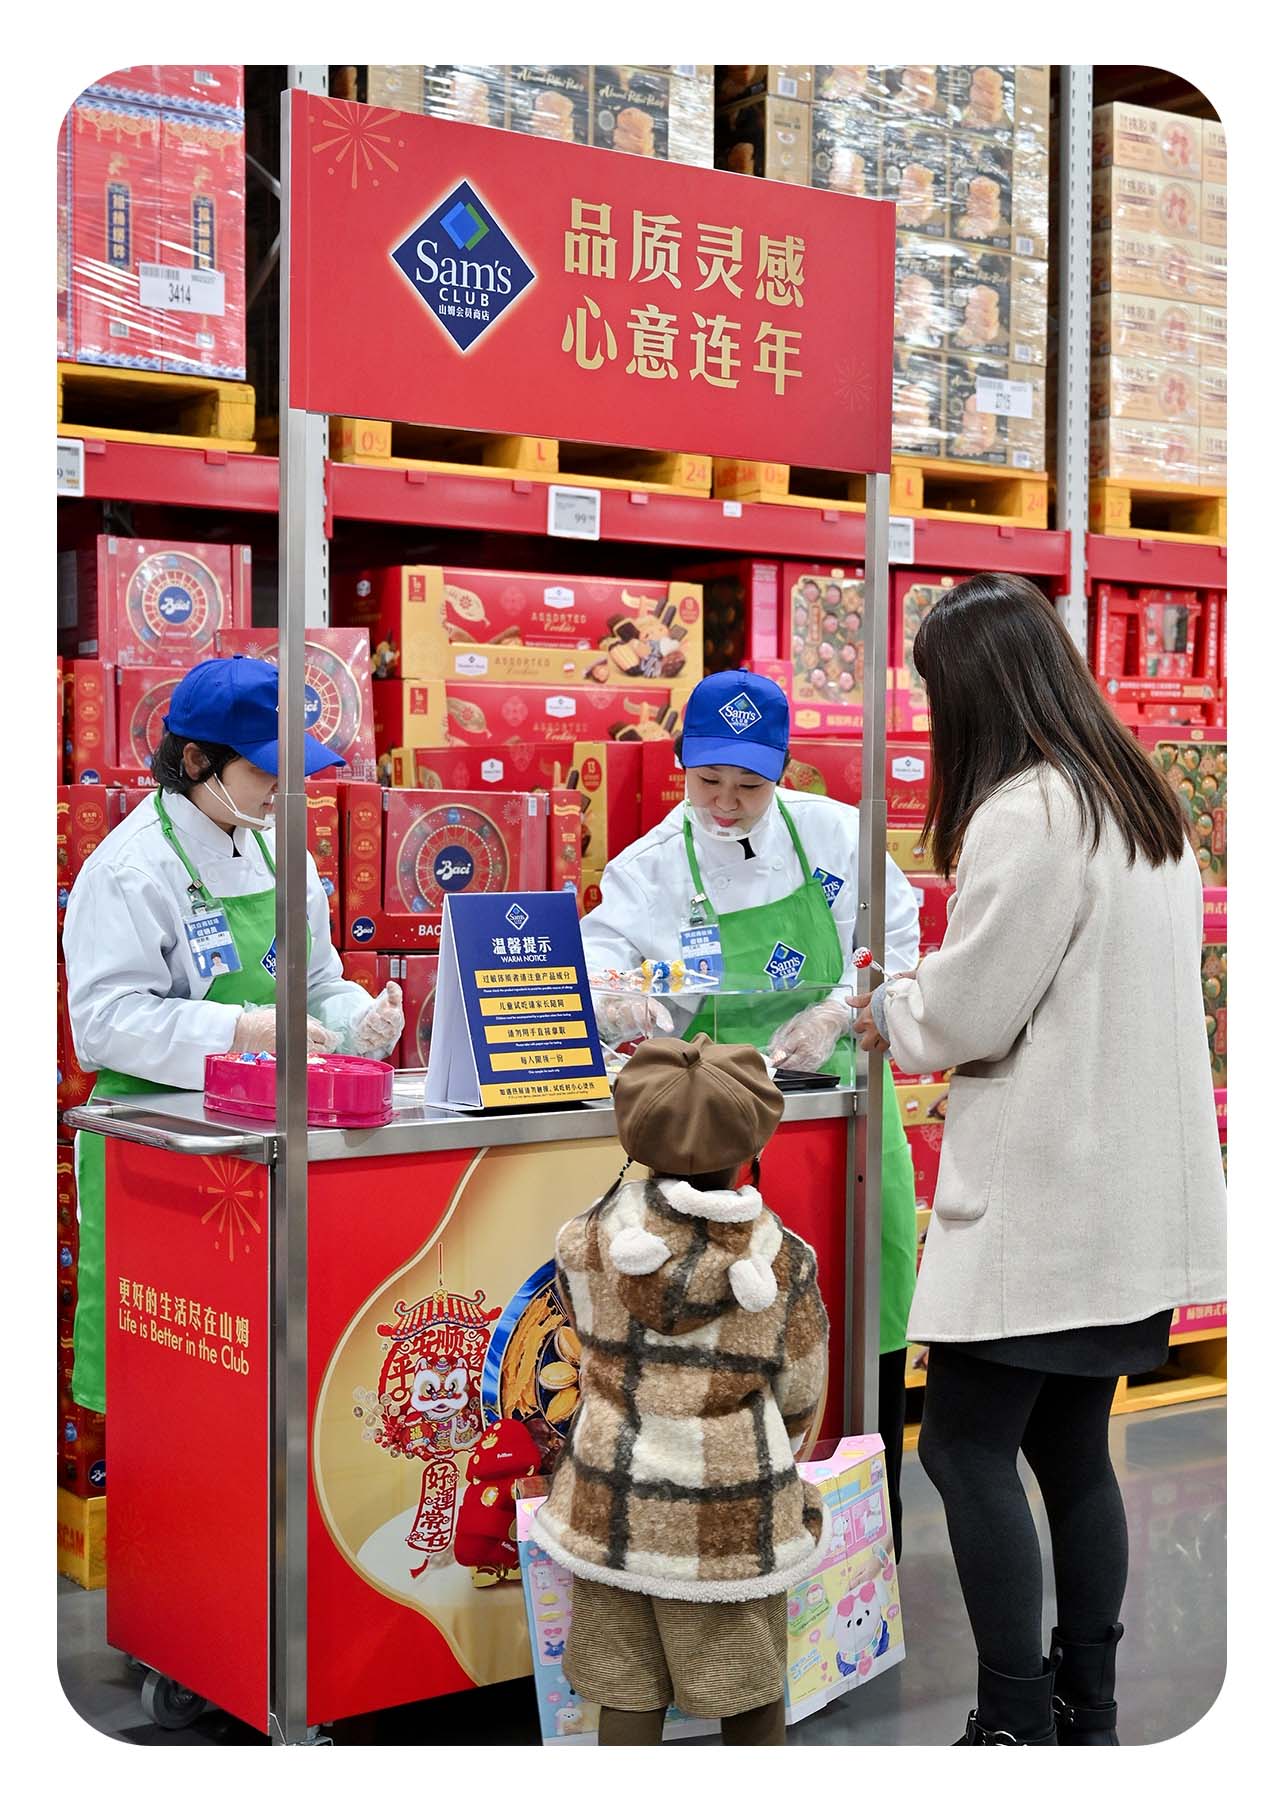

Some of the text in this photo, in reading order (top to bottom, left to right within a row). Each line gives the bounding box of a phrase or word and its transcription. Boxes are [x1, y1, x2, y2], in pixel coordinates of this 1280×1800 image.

[563, 197, 807, 308] 品质灵感
[415, 239, 513, 295] Sam's
[438, 287, 490, 307] CLUB
[438, 304, 490, 321] 山姆会员商店
[560, 293, 804, 396] 心意连年
[724, 705, 756, 721] Sam's
[436, 860, 471, 881] Baci
[353, 925, 373, 937] Baci
[491, 936, 553, 955] 温馨提示
[500, 954, 548, 963] WARM NOTICE
[770, 954, 801, 975] Sam's
[118, 1276, 249, 1348] 更好的生活尽在山姆
[119, 1307, 250, 1376] Life is Better in the Club
